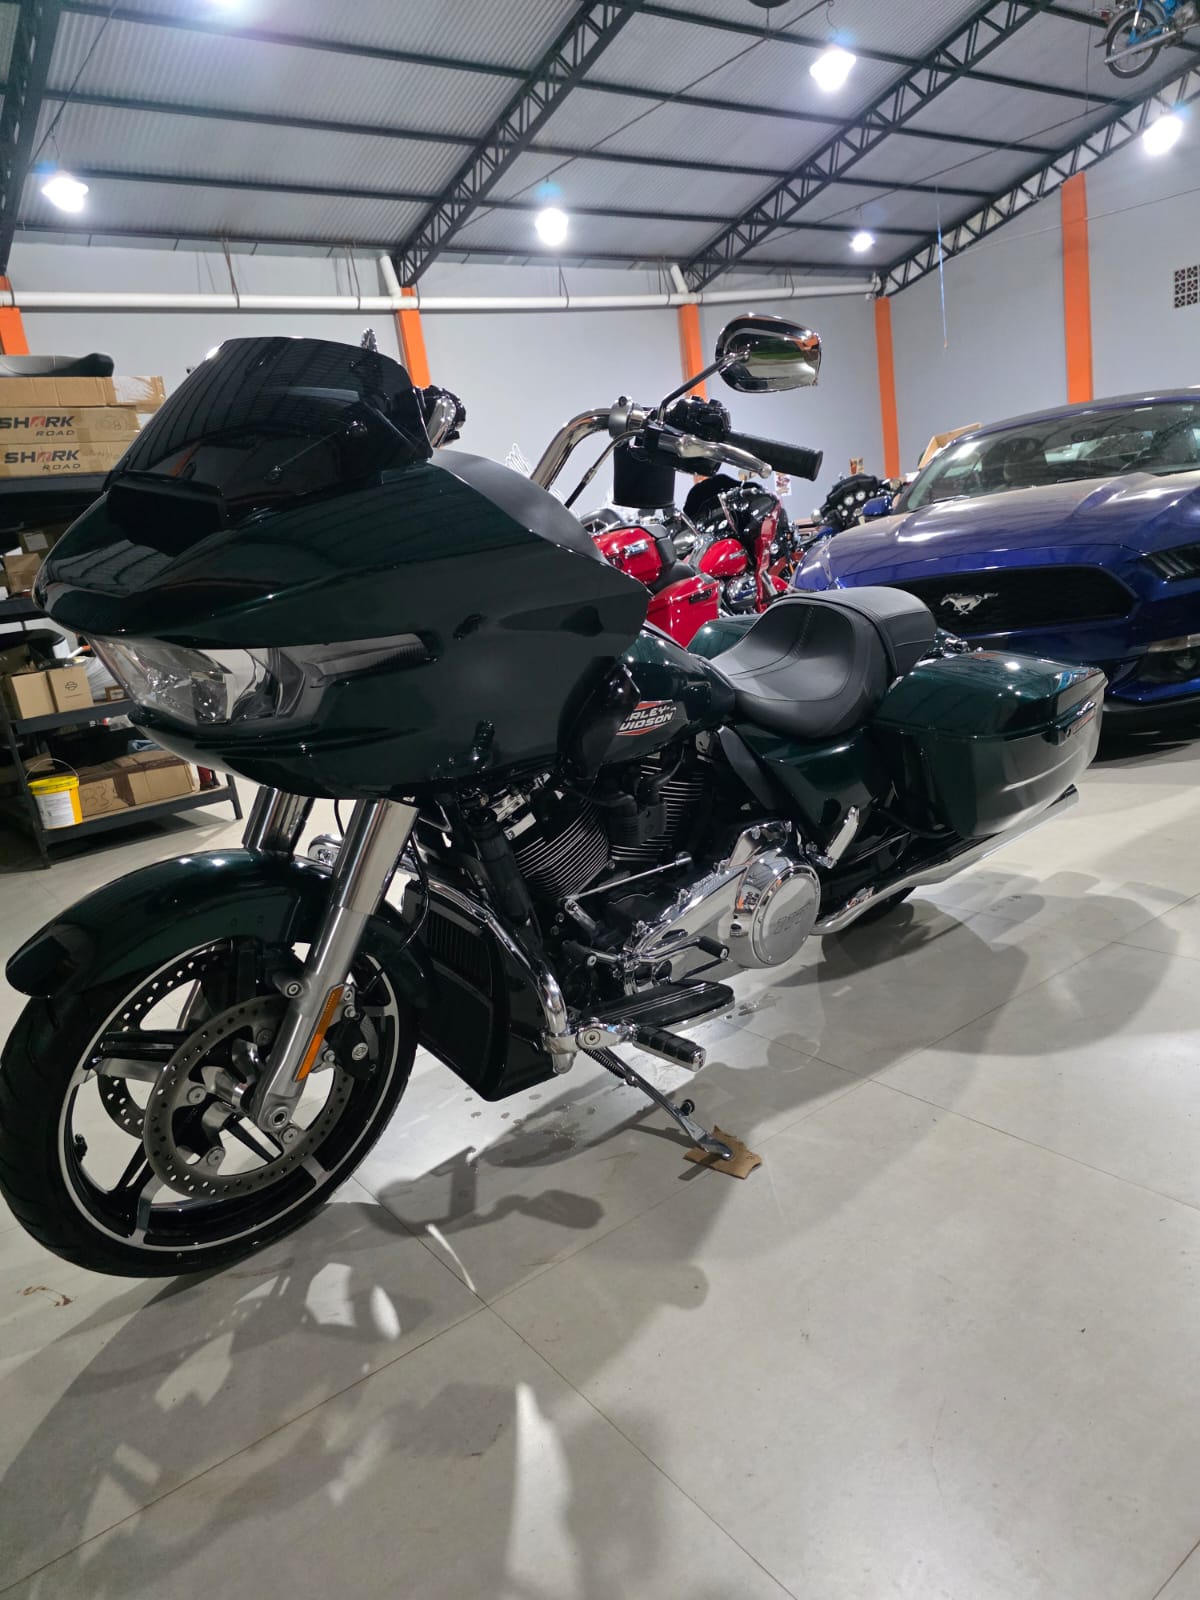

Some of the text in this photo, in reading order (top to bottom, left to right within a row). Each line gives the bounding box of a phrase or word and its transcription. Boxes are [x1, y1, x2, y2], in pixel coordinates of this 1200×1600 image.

[0, 416, 76, 430] SHARK
[4, 450, 79, 464] SHARK
[42, 463, 81, 471] ROAD
